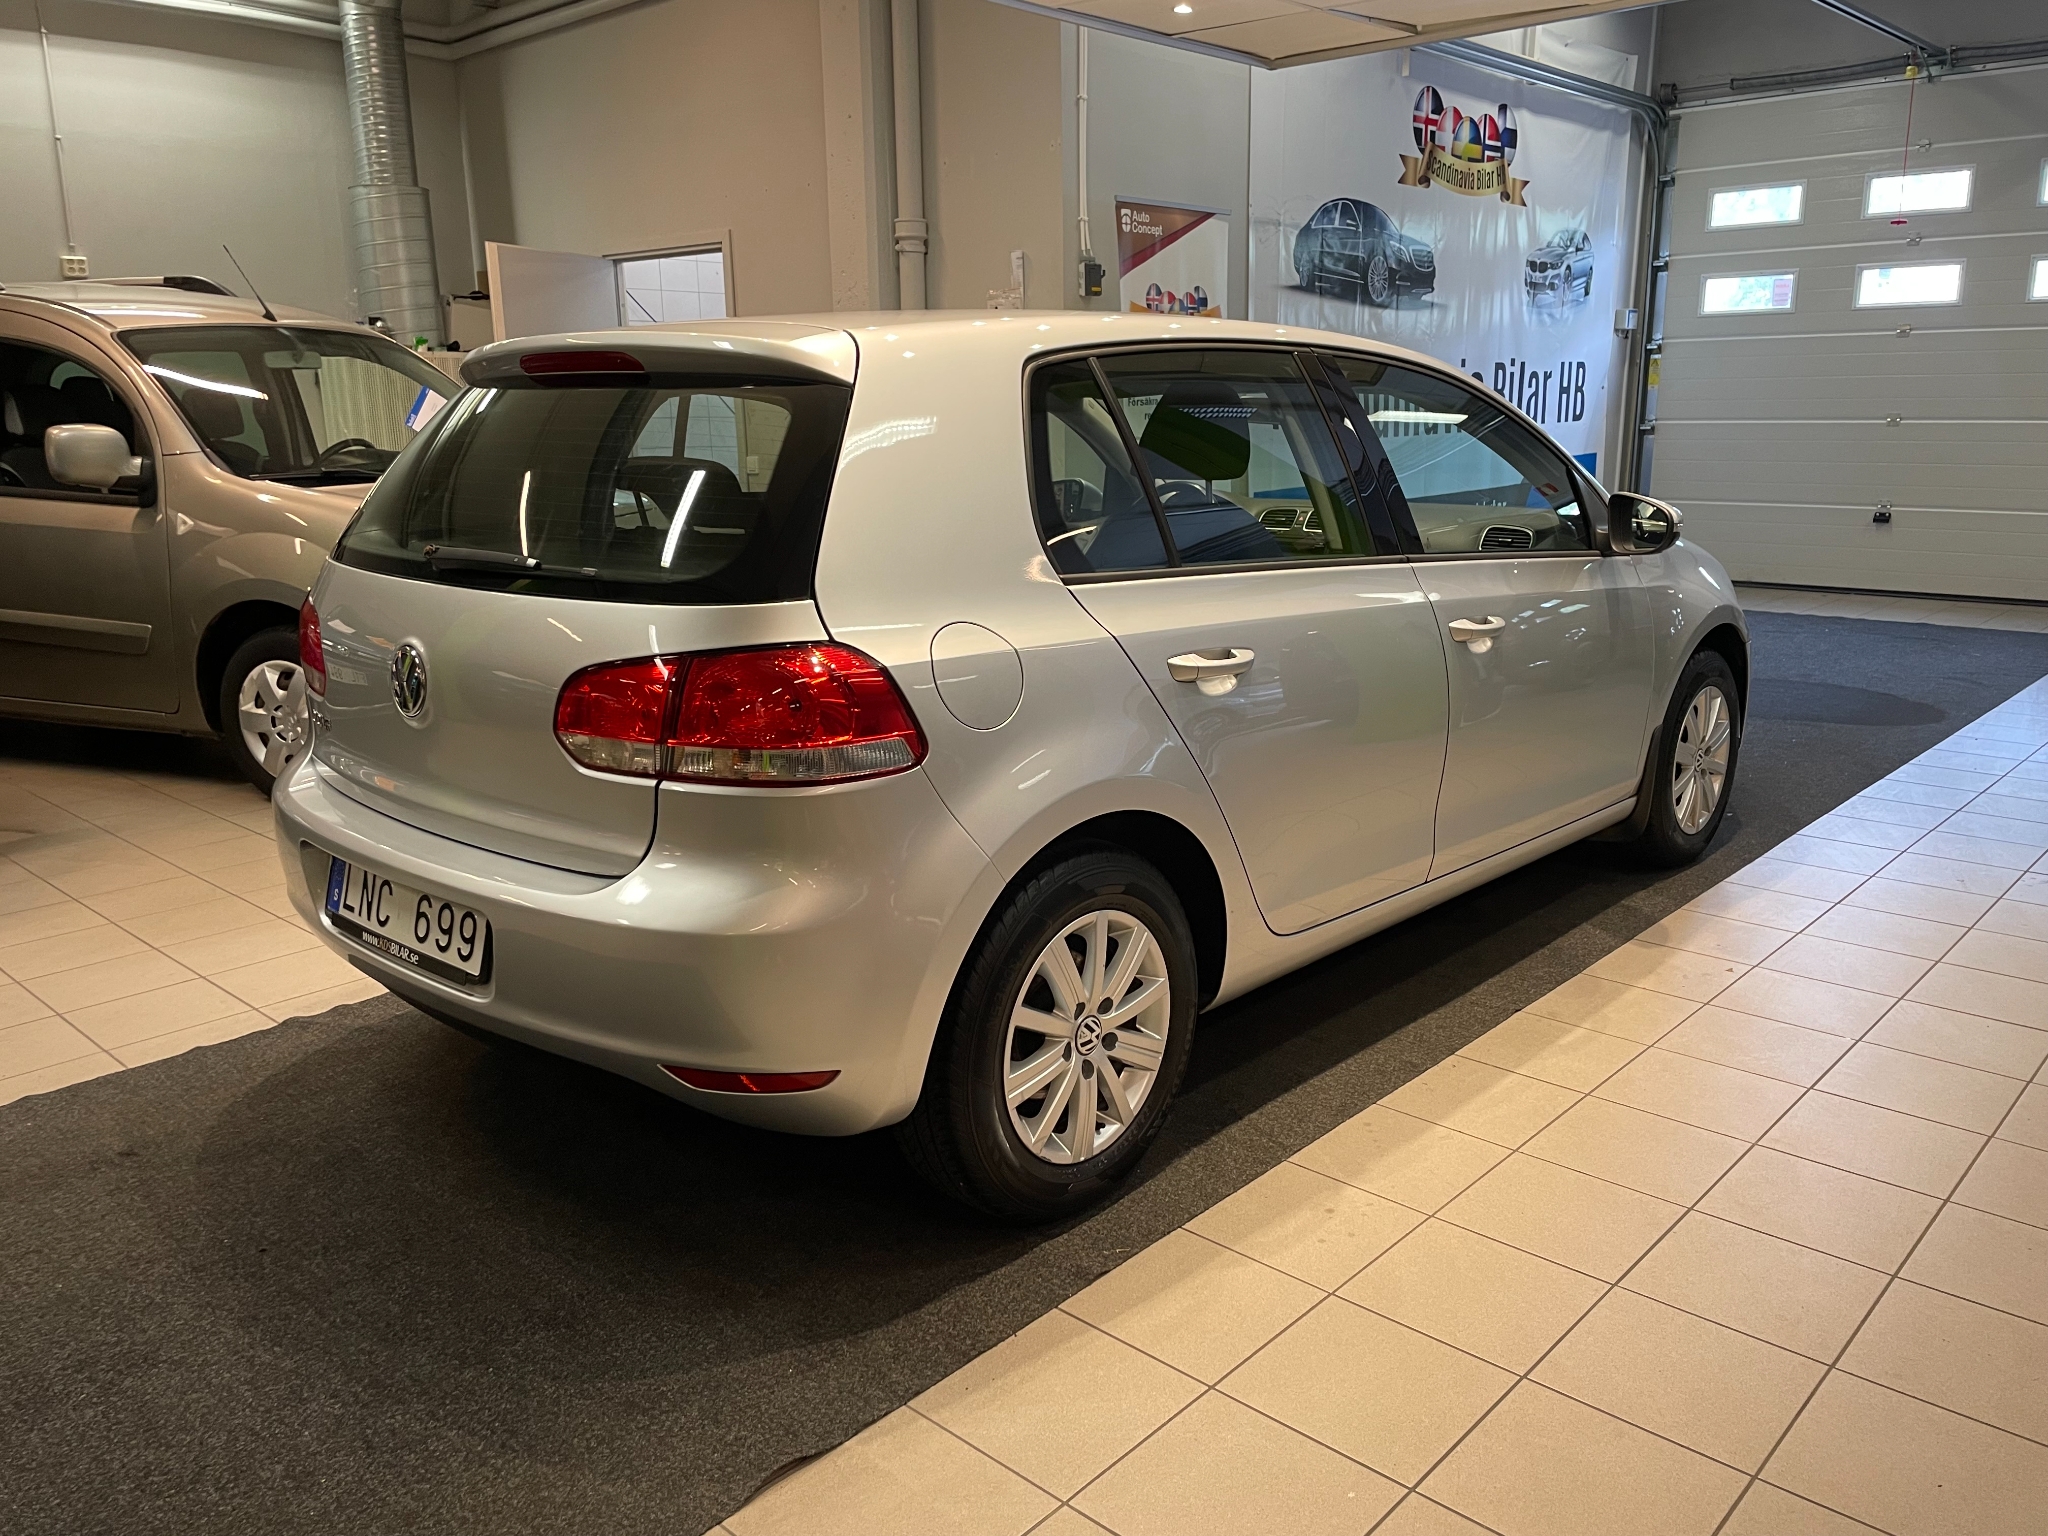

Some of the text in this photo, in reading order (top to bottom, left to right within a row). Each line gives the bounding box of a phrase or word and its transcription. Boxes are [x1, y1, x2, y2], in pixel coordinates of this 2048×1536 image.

[1427, 150, 1475, 190] Scandinavia
[1476, 168, 1494, 190] Bilar
[1132, 210, 1150, 223] Auto
[1132, 221, 1163, 237] Concept
[1557, 361, 1586, 423] HB
[342, 862, 478, 963] LNC 699
